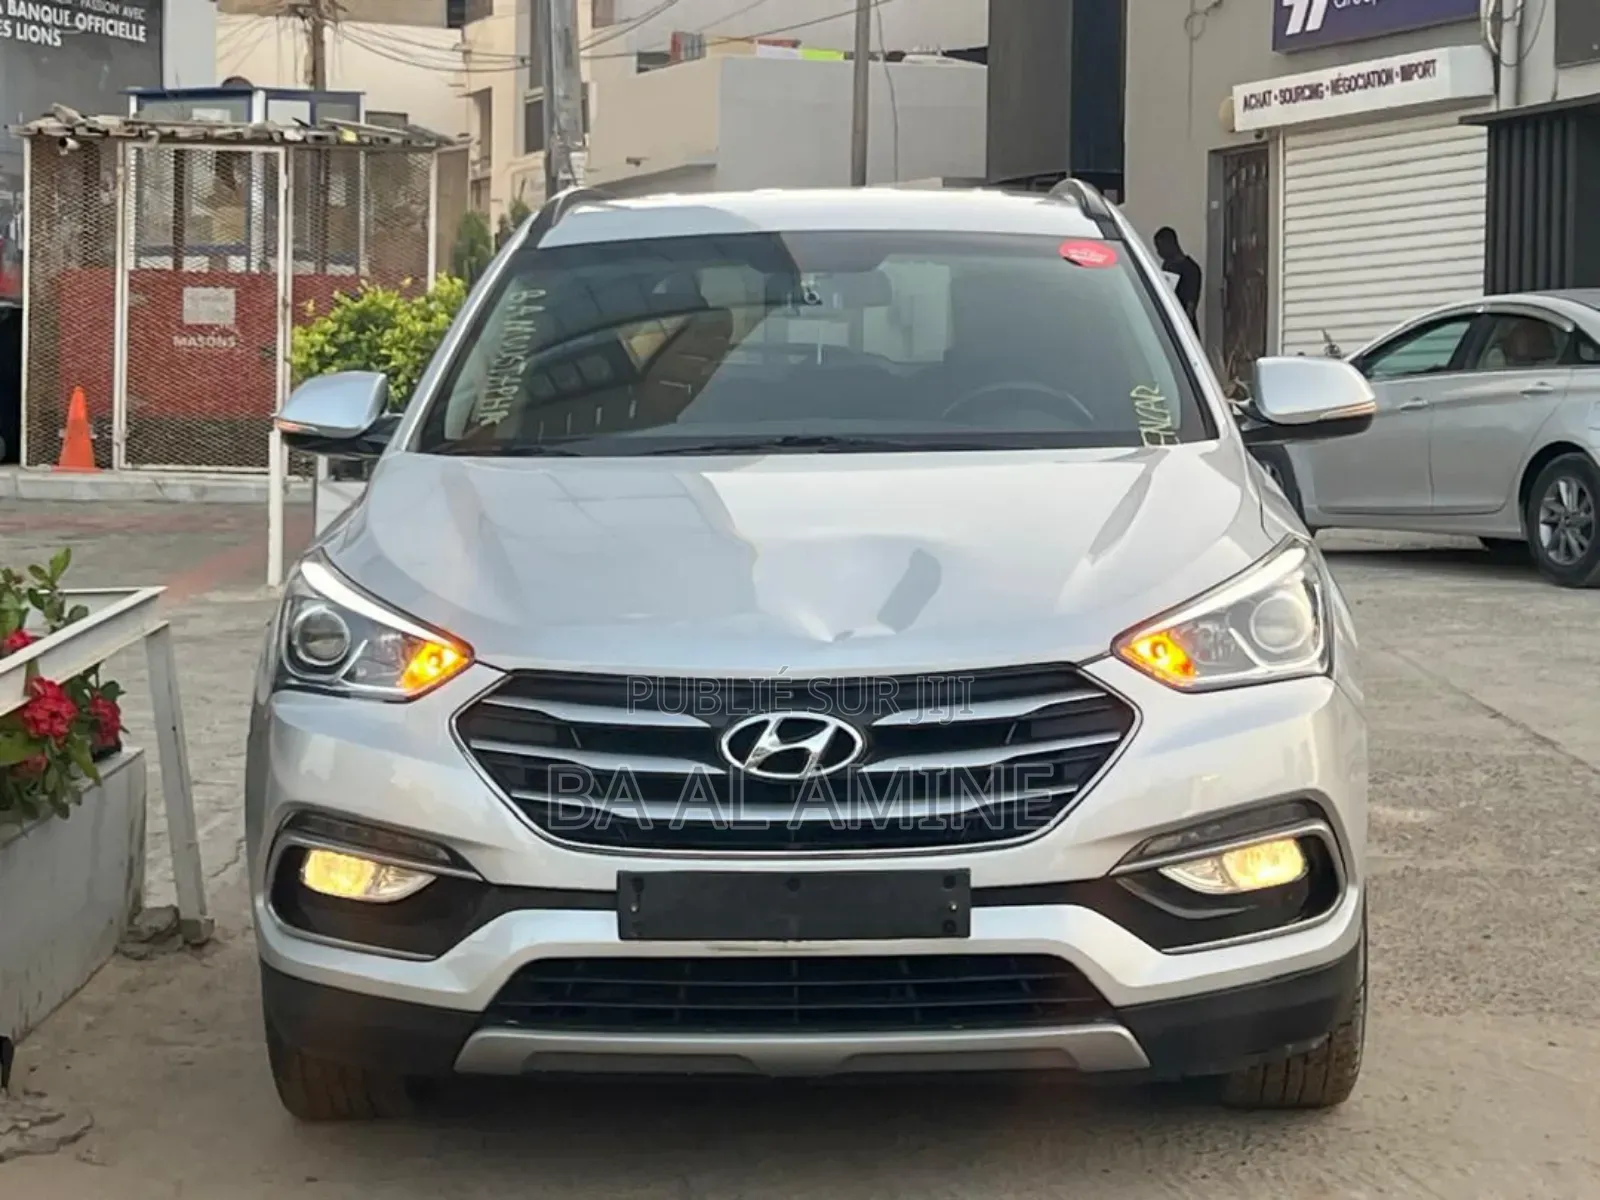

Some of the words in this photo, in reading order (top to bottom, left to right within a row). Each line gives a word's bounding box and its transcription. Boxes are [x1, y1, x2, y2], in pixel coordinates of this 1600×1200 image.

[7, 0, 71, 27] BANQUE
[75, 12, 147, 43] OFFICIELLE
[122, 6, 146, 20] AVEC
[16, 22, 61, 47] LIONS
[1243, 90, 1272, 113] ACHAT
[1279, 82, 1324, 105] SOURCING
[1400, 59, 1437, 82] IMPORT
